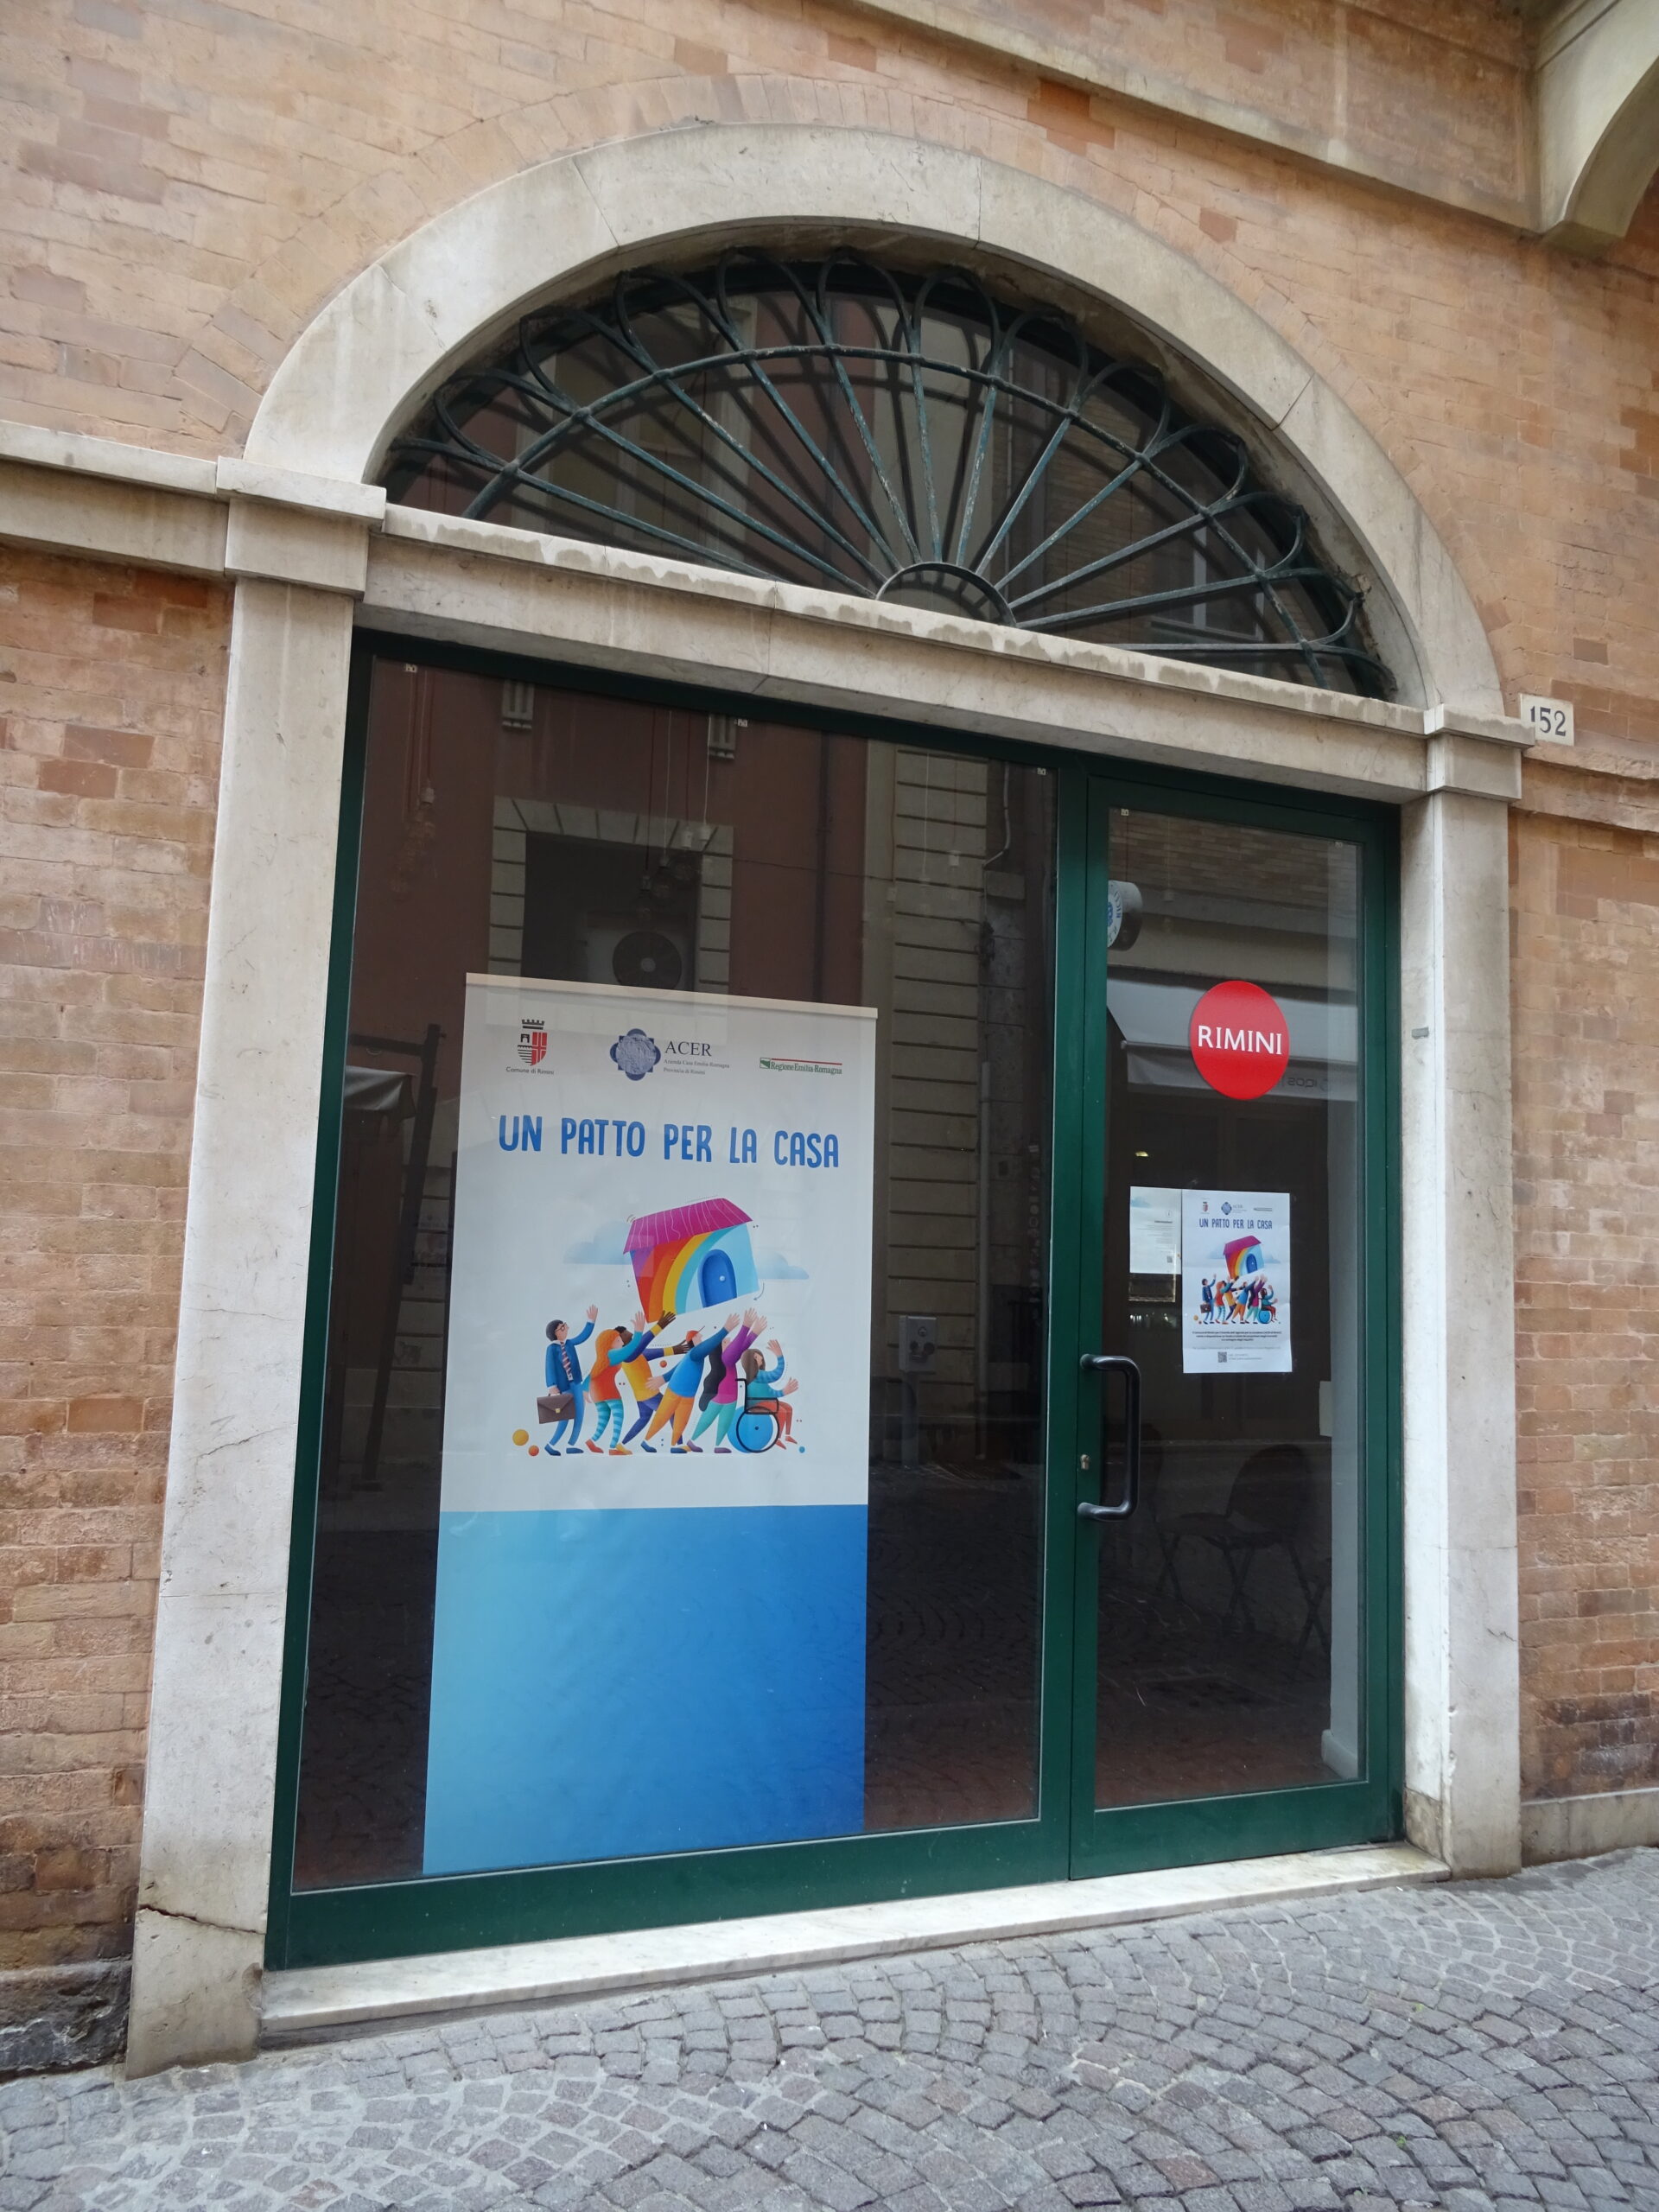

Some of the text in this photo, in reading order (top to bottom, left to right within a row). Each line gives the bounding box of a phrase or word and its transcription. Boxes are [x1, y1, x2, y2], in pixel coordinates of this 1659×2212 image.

[1530, 706, 1567, 737] 152
[664, 1040, 712, 1057] ACER
[1198, 1025, 1282, 1055] RIMINI
[499, 1115, 839, 1168] UN PATTO PER LA CASA
[1199, 1218, 1273, 1230] UN PATTO PER LA CASA
